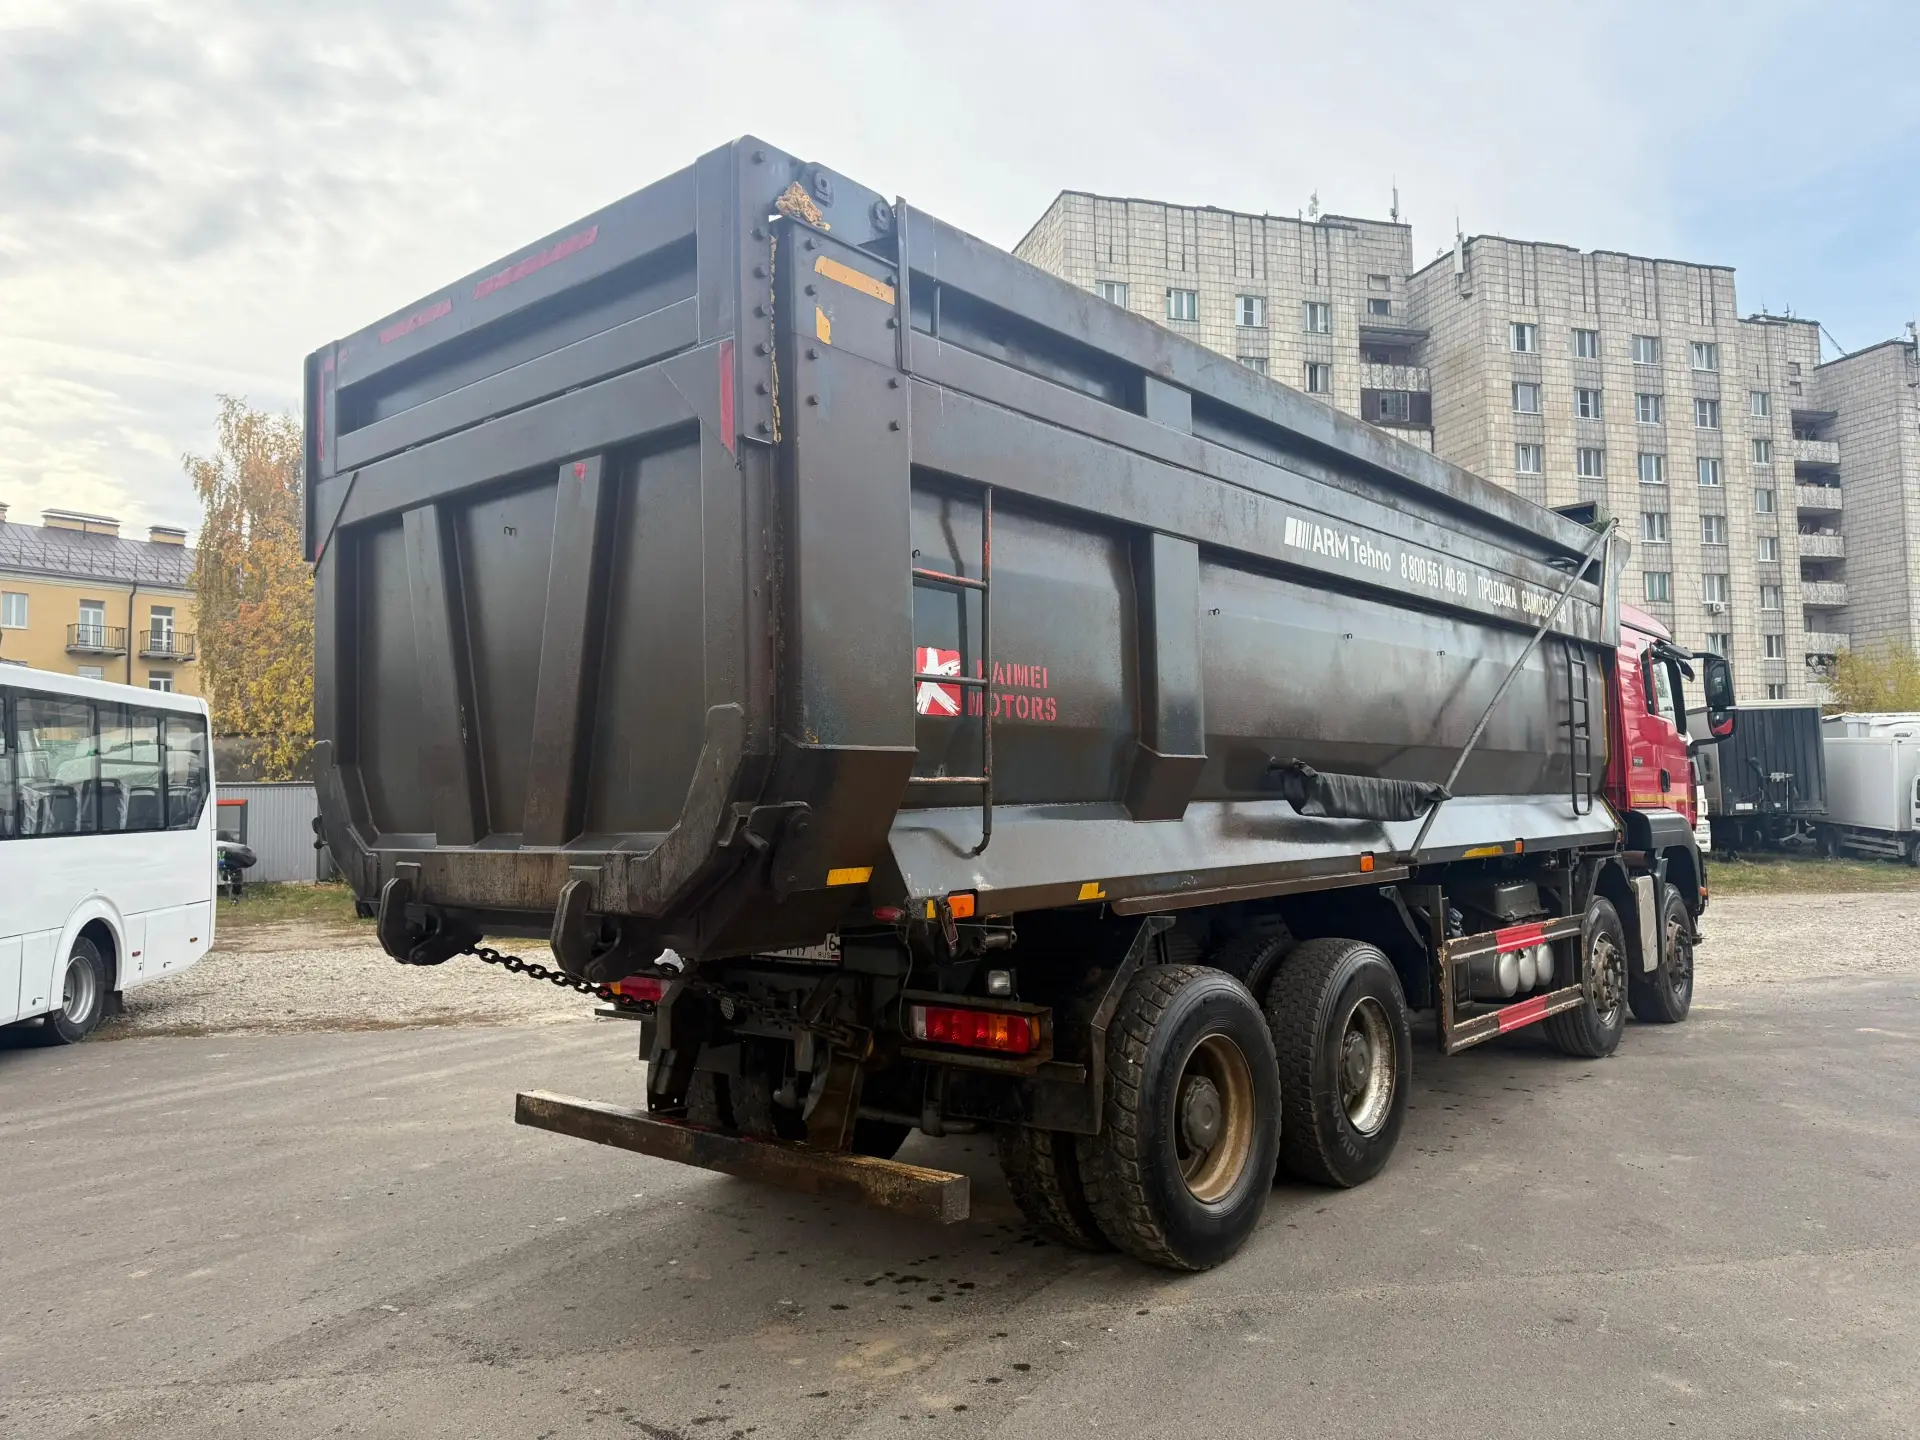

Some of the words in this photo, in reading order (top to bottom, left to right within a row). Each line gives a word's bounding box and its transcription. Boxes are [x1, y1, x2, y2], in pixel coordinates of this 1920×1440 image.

[1312, 524, 1350, 561] ARM
[1351, 535, 1392, 573] Tehno
[1400, 552, 1408, 579] 8
[1408, 554, 1426, 585] 800
[1427, 560, 1444, 590] 551
[1444, 566, 1456, 593] 40
[1456, 570, 1468, 597] 80
[1477, 575, 1518, 610] ПРОДАЖА
[817, 951, 832, 959] RUS
